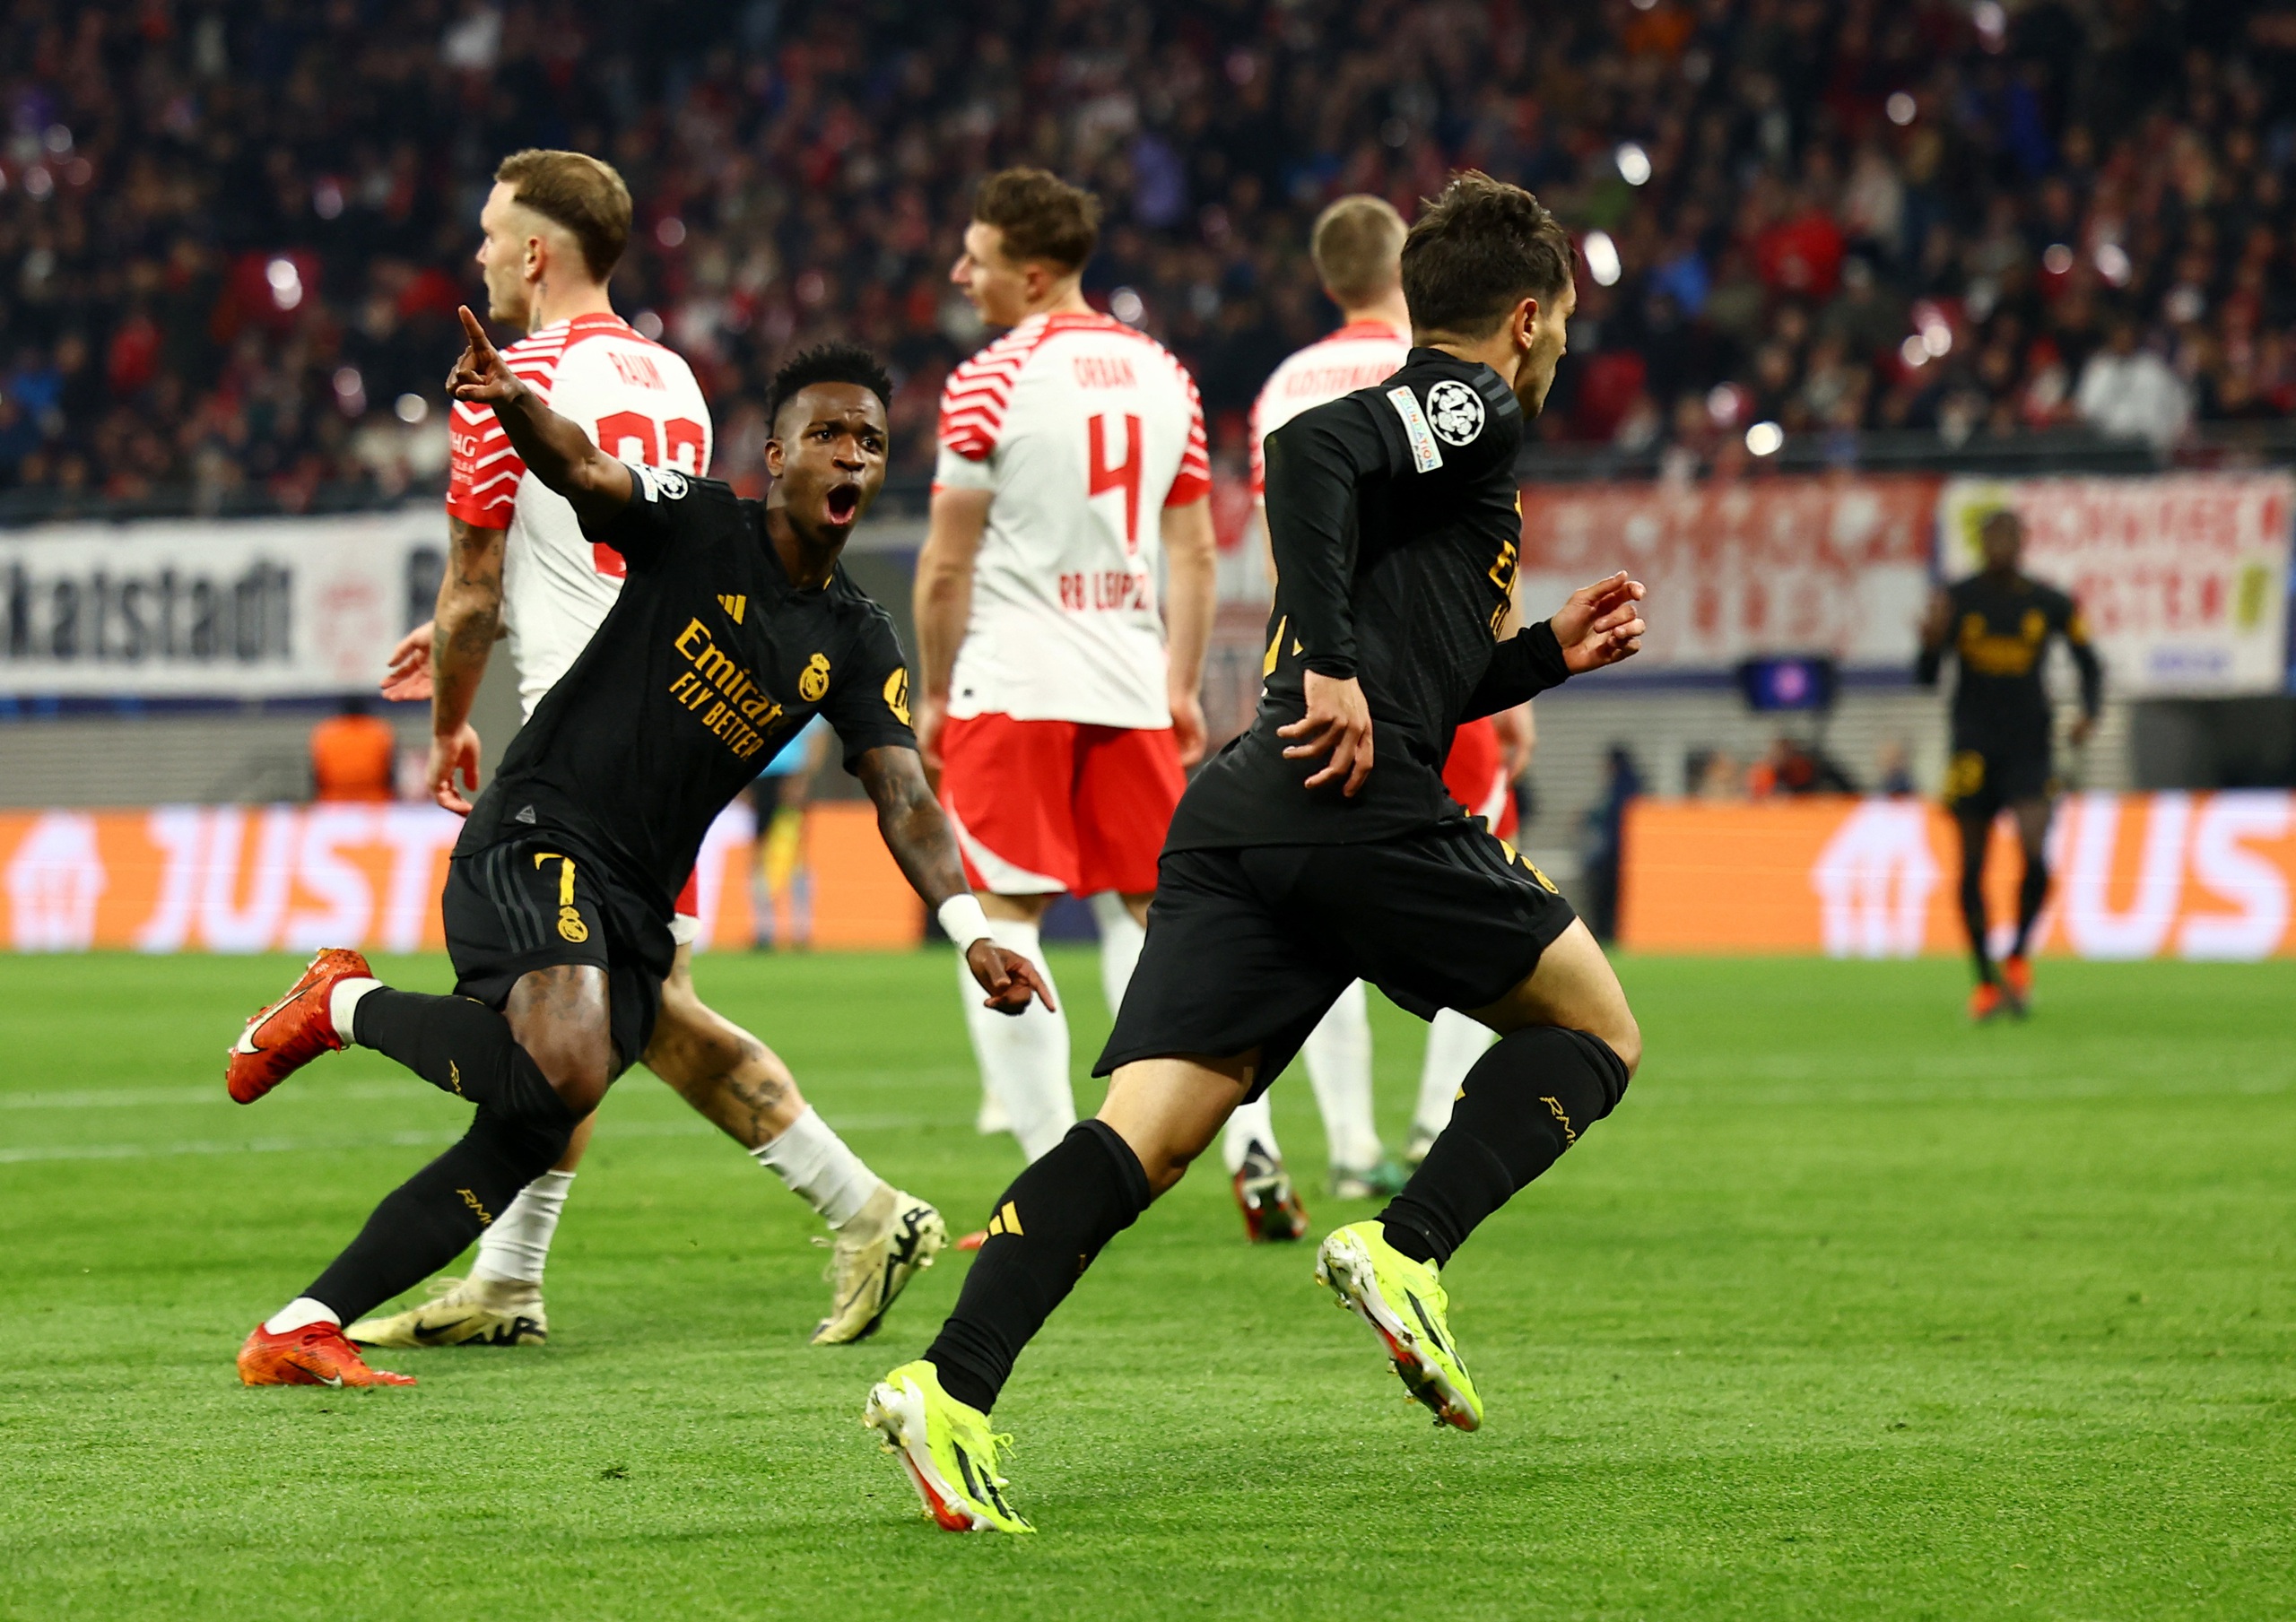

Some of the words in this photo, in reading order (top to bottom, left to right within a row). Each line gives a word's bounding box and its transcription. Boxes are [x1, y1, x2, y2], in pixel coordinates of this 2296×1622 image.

[607, 351, 666, 392] RAUM
[1396, 390, 1435, 469] FOUNDATION
[1087, 412, 1142, 556] 4
[1059, 571, 1085, 611] RB
[1093, 571, 1149, 611] LEIPZ
[674, 617, 786, 729] Emirat
[668, 671, 715, 711] FLY
[701, 700, 765, 760] BETTER
[135, 802, 468, 955] JUST
[534, 853, 577, 906] 7
